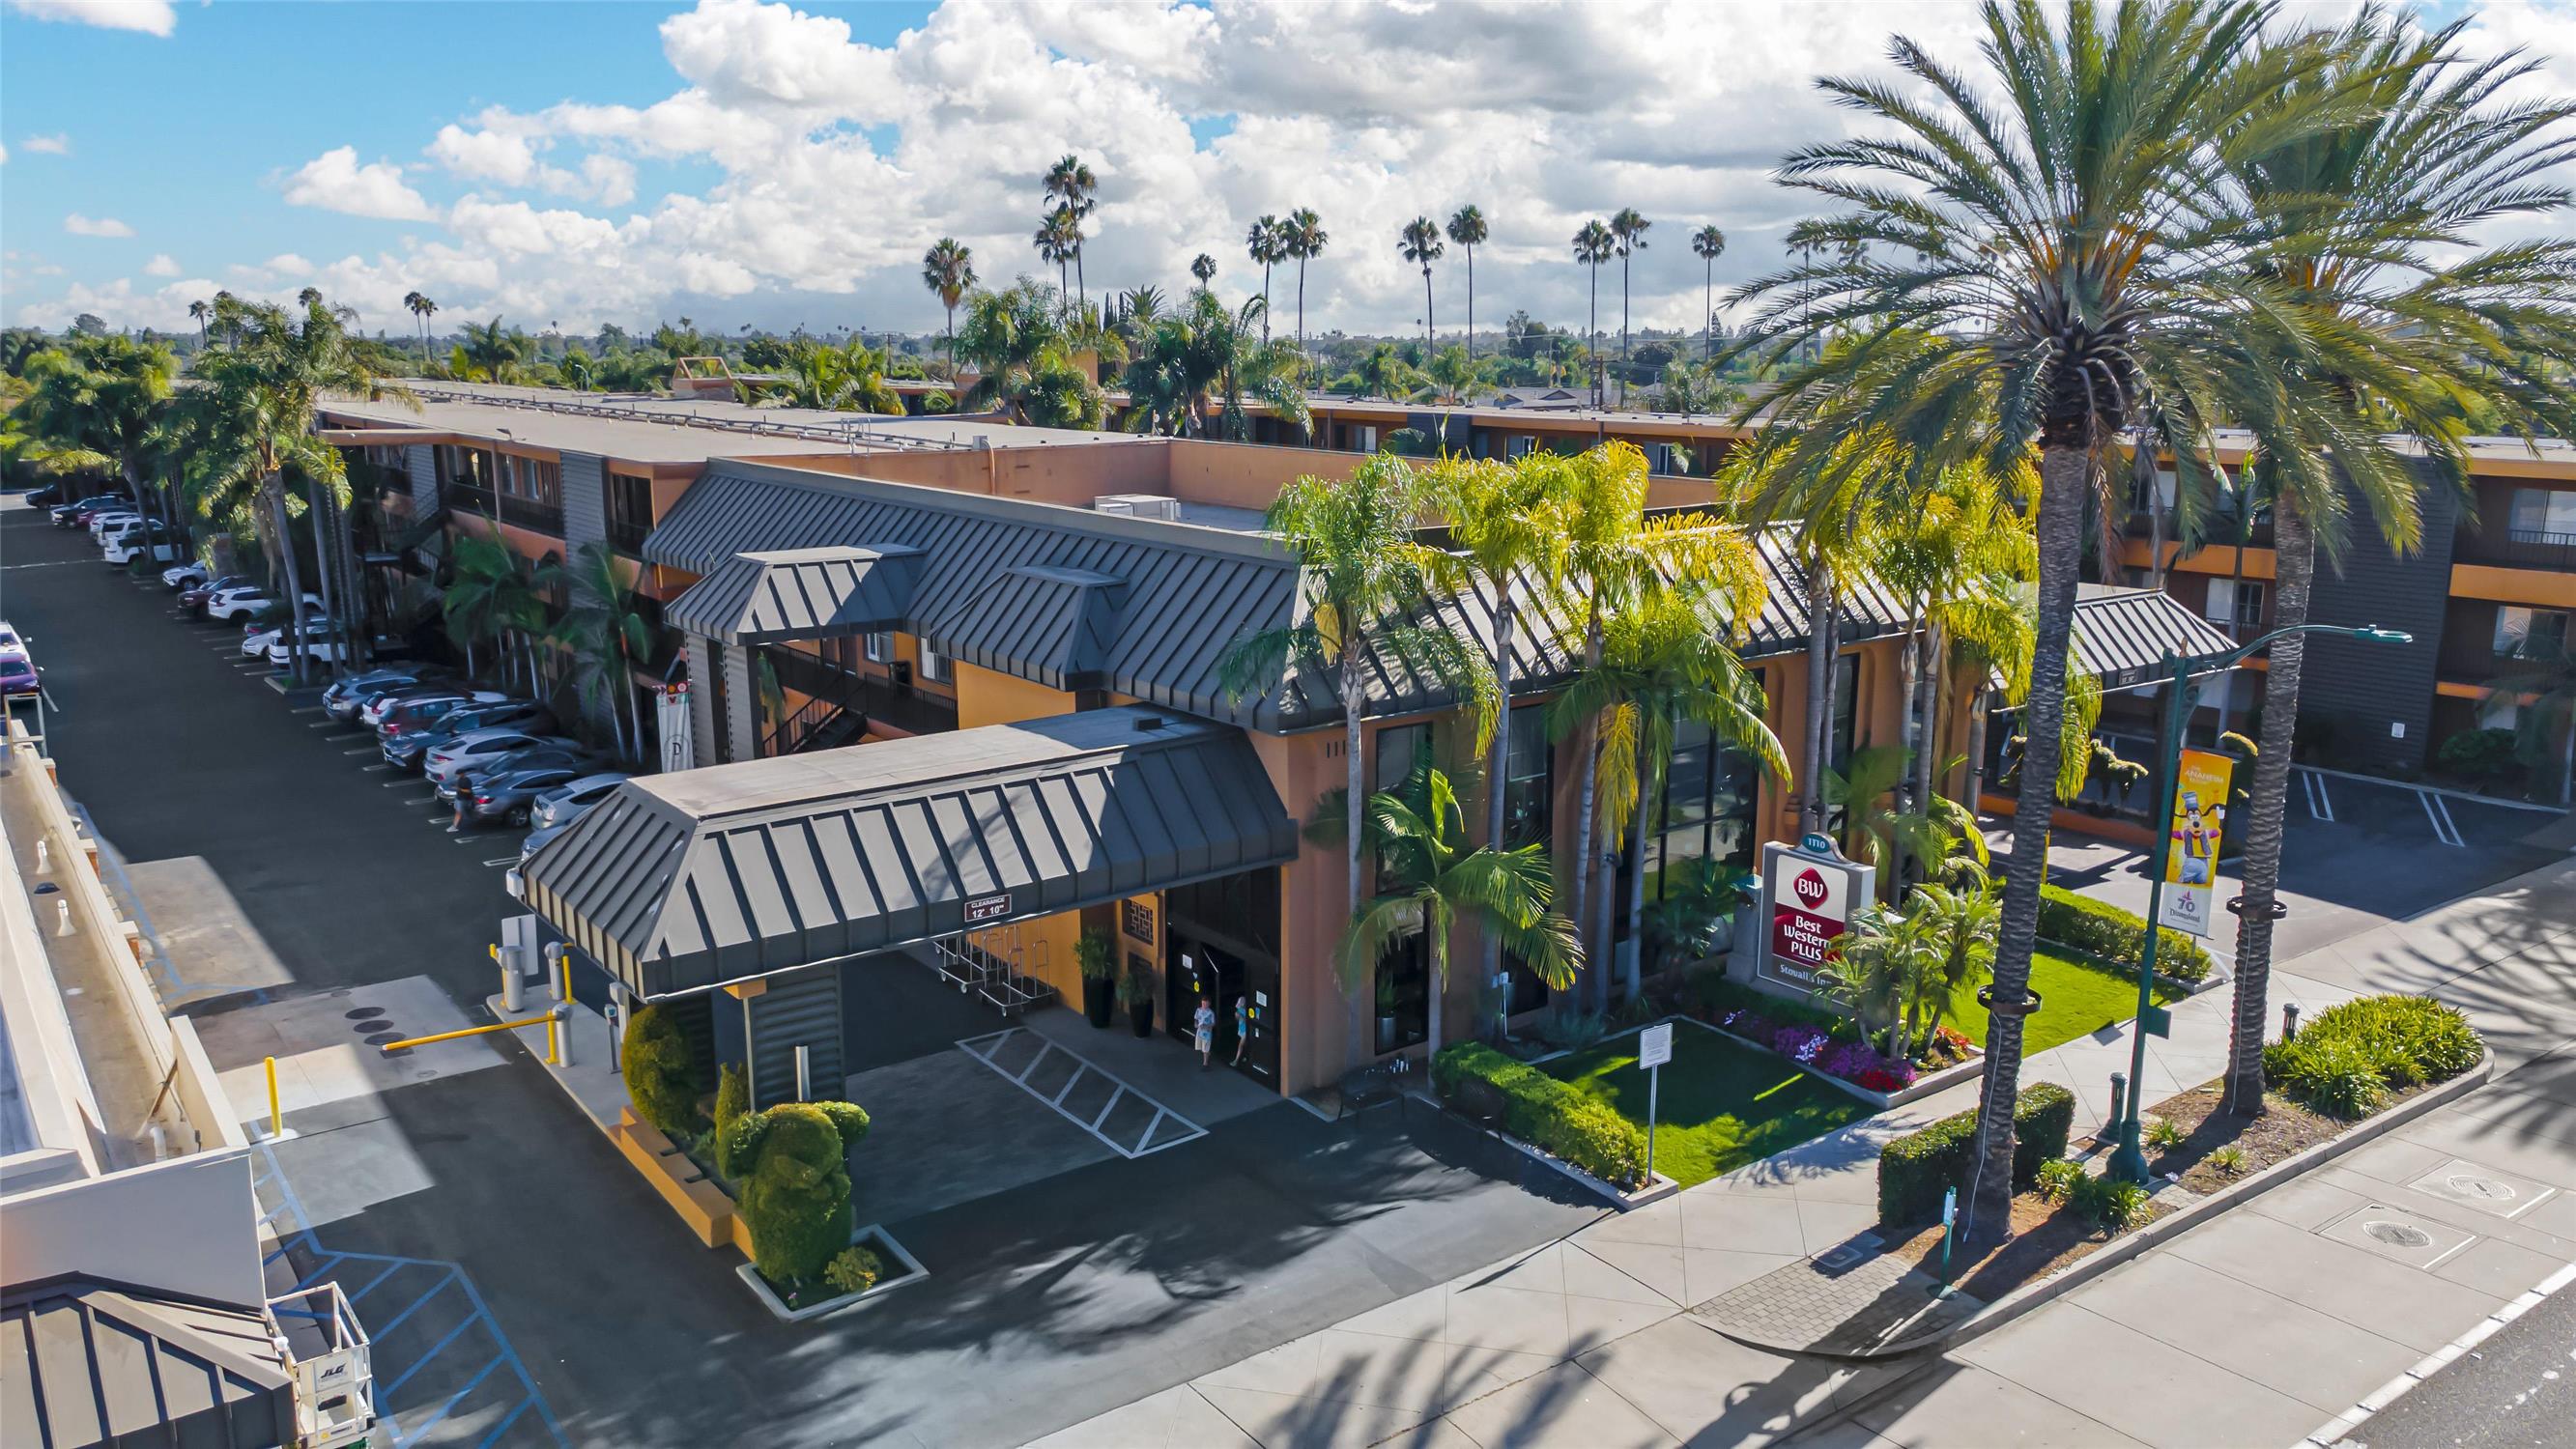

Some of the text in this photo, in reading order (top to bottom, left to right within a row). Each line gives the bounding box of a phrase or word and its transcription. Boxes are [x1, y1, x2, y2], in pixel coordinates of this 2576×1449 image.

[1808, 838, 1826, 849] 1110
[1797, 878, 1824, 898] BW
[971, 896, 1005, 909] CLEARANCE
[2178, 897, 2195, 913] 70
[1795, 915, 1822, 934] Best
[1784, 923, 1831, 949] Western
[1790, 941, 1822, 961] PLUS
[320, 1362, 347, 1378] JLG
